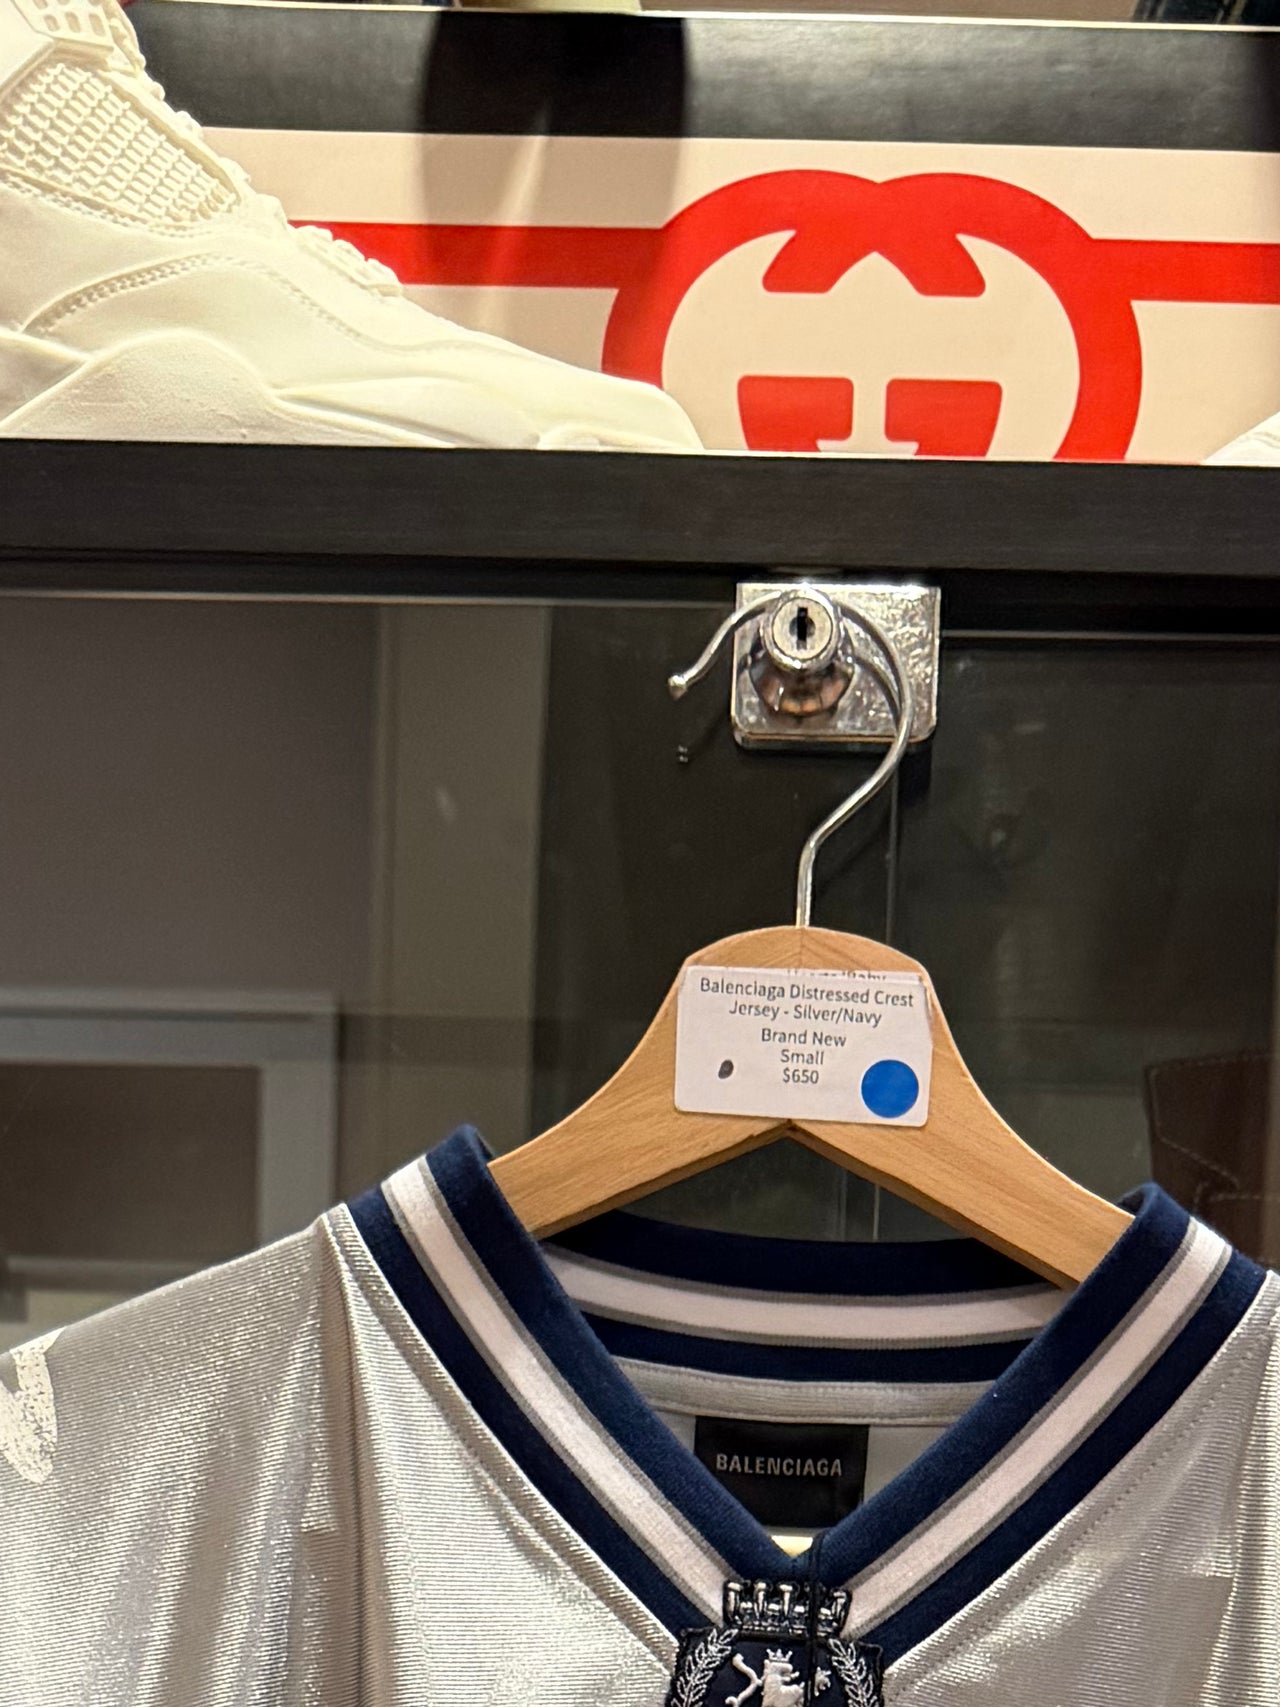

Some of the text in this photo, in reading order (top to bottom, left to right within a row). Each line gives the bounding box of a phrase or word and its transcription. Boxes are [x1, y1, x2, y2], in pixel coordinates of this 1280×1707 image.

[700, 977, 914, 1007] Balenciaga Distressed Crest
[729, 1000, 781, 1020] Jersey
[793, 1004, 882, 1028] Silver/Navy
[761, 1028, 847, 1048] Brand New
[780, 1049, 825, 1065] Small
[782, 1067, 819, 1084] $650
[716, 1453, 842, 1477] BALENCIAGA
